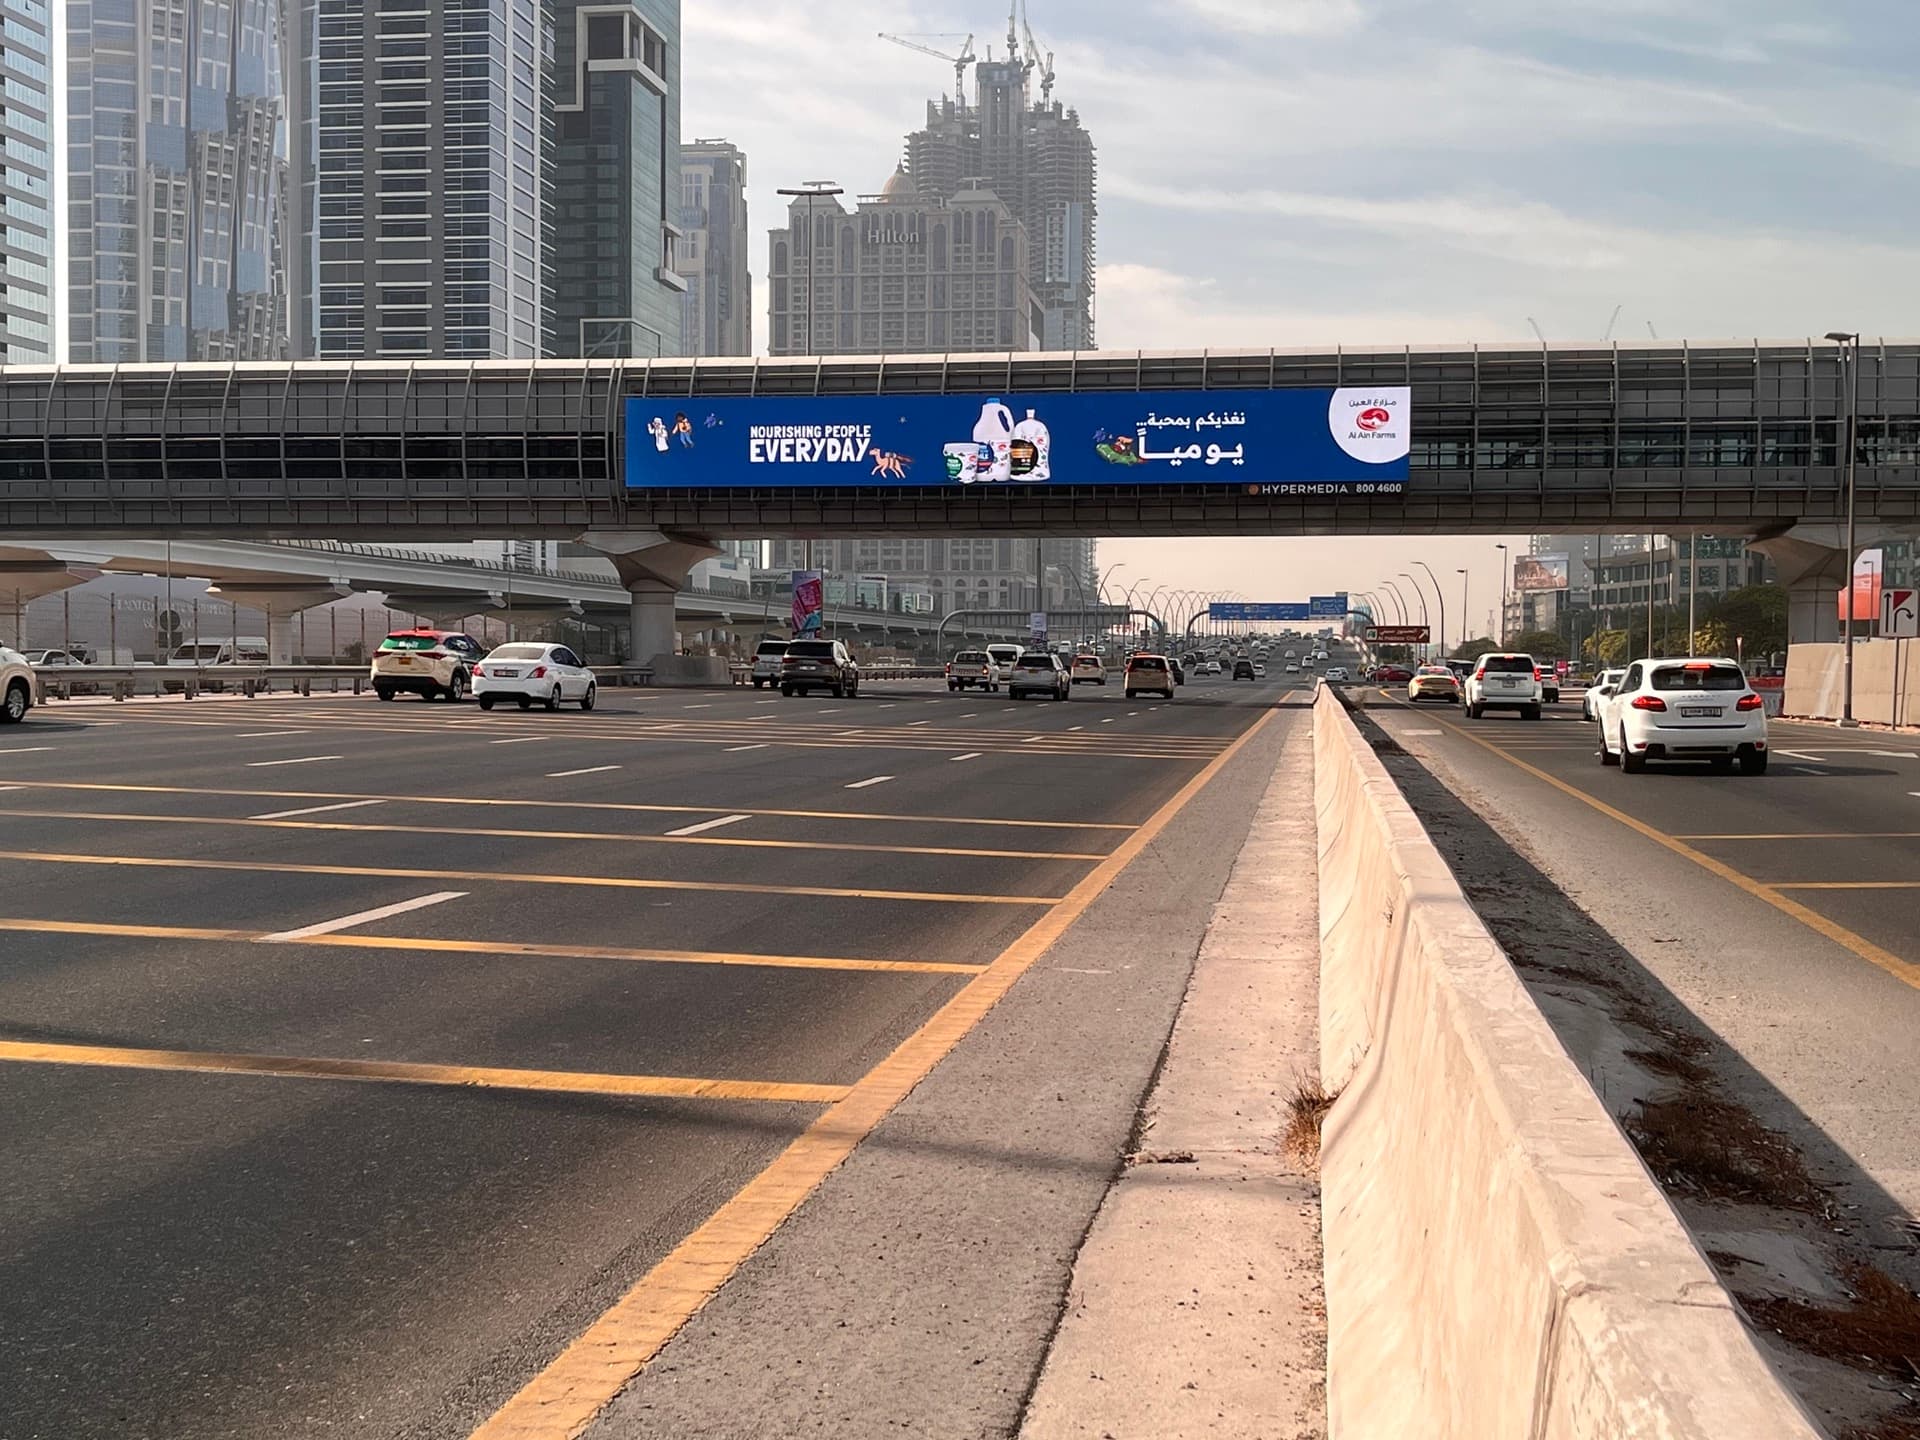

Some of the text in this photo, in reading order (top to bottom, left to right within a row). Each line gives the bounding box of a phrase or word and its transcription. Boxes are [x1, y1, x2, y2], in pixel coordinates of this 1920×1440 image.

[867, 229, 919, 243] Hilton
[1348, 399, 1397, 408] مزارع العين
[1195, 411, 1245, 432] نغذيكم
[749, 424, 872, 438] NOURISHING PEOPLE
[1371, 431, 1396, 439] Farms
[749, 437, 871, 463] EVERYDAY
[1262, 483, 1402, 494] HYPERMEDIA 800 4600
